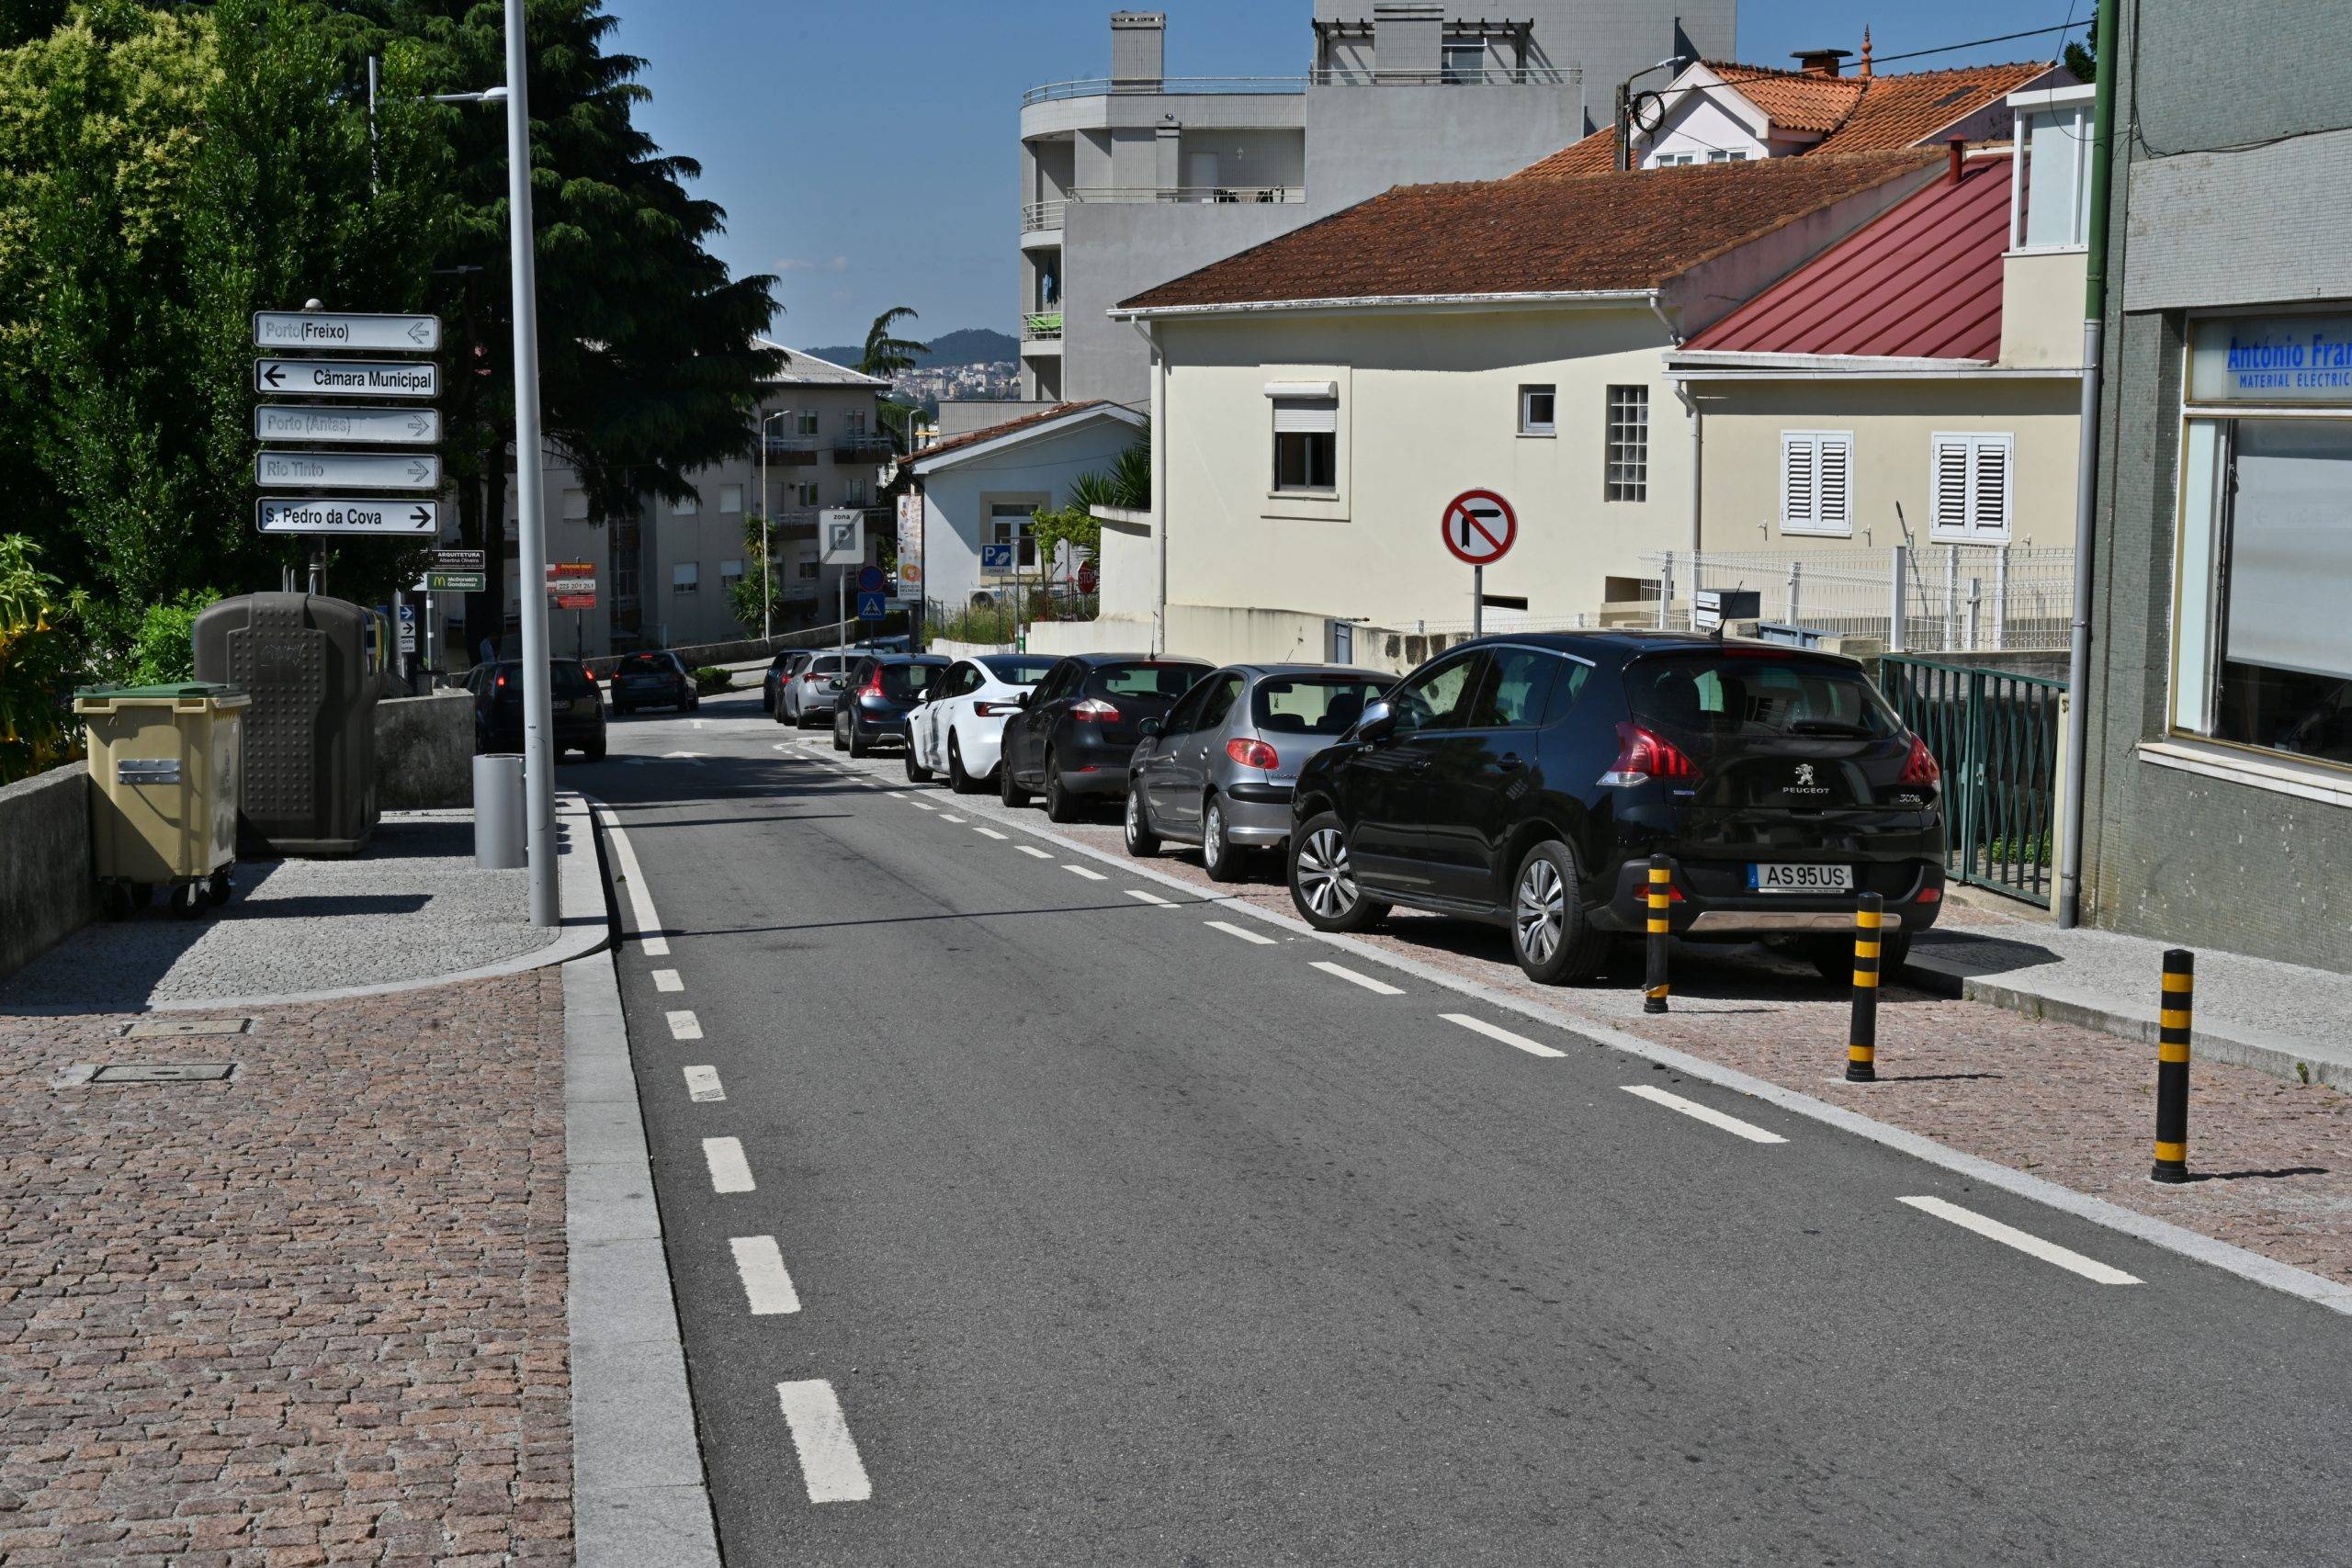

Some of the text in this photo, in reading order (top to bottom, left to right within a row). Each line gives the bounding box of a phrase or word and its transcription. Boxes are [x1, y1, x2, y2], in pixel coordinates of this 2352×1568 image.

[2227, 335, 2303, 368] António
[313, 369, 431, 391] Câmara Municipal
[2240, 374, 2290, 388] MATERIAL
[267, 415, 351, 434] Porto (Antas)
[267, 461, 324, 477] Rio Tinto
[266, 507, 381, 525] S. Pedro da Cova
[1079, 571, 1096, 584] STOP
[1899, 794, 1921, 803] 3008
